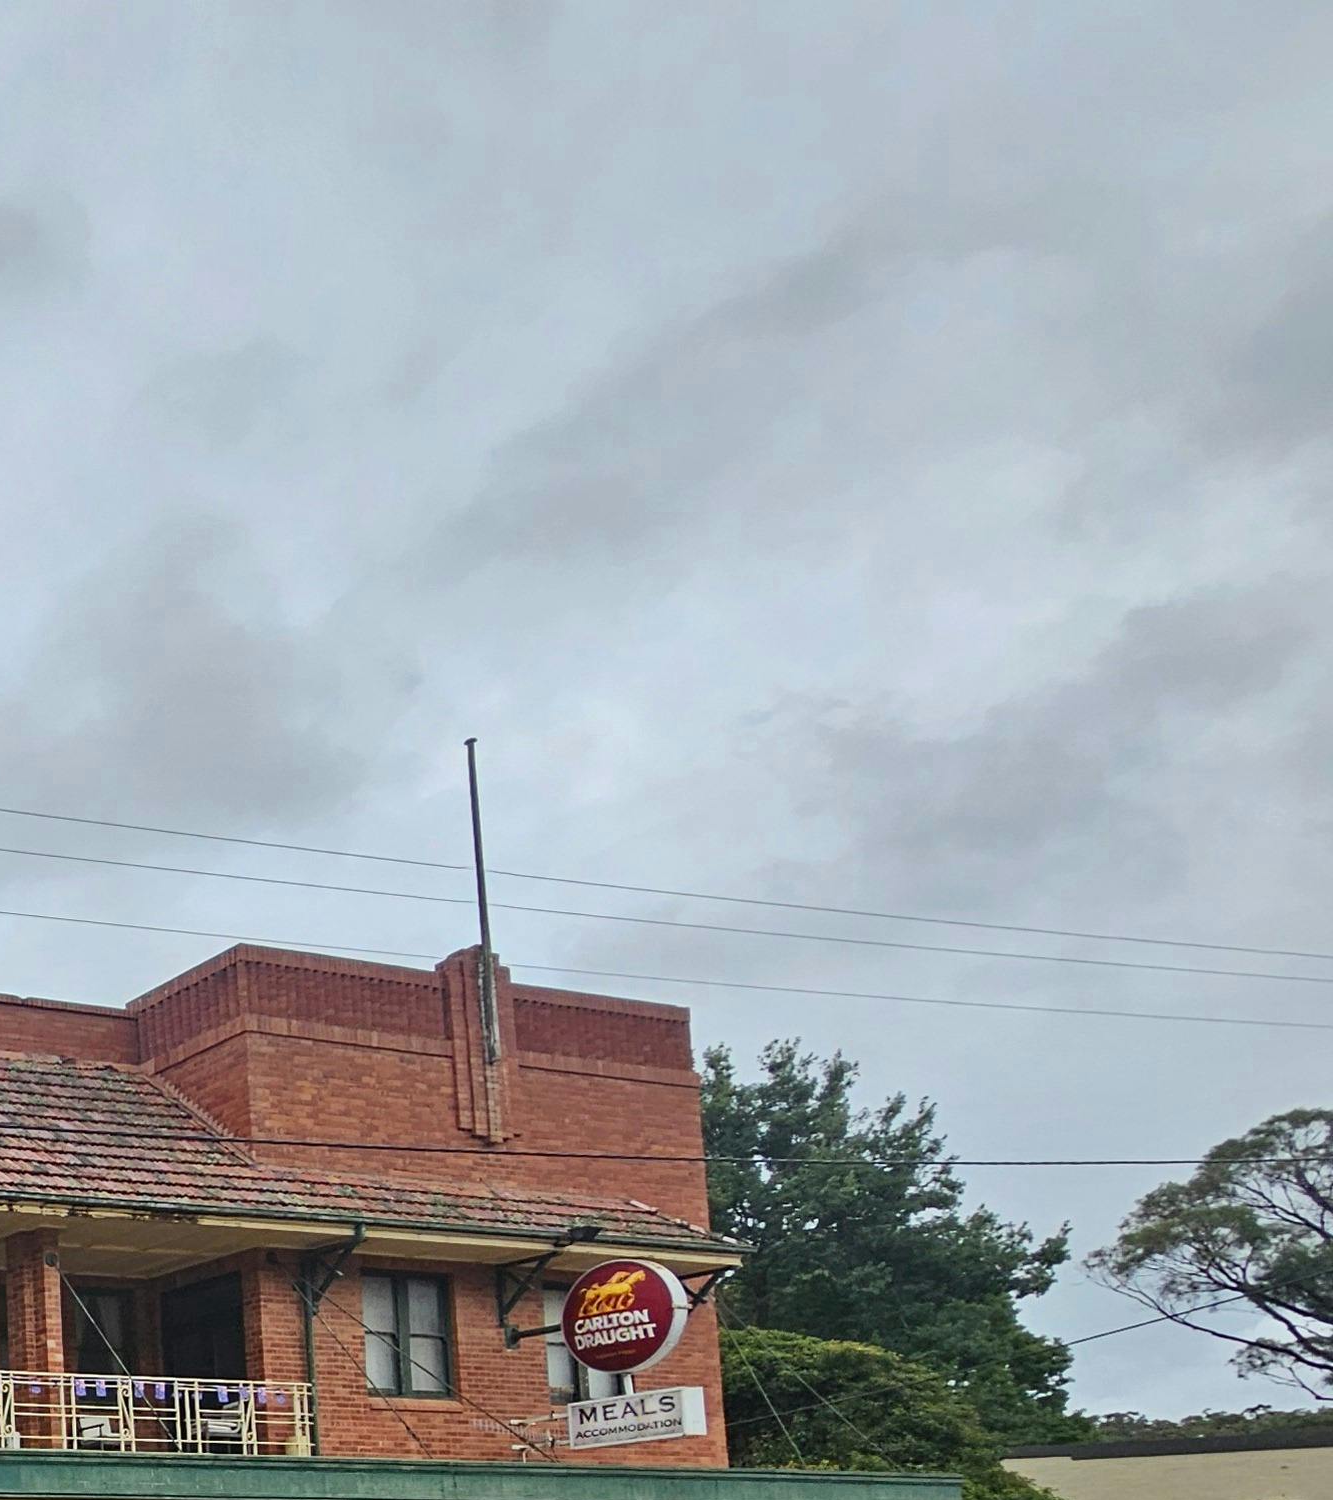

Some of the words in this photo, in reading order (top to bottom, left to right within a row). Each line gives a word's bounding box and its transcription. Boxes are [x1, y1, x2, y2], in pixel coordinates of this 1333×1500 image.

[574, 1308, 649, 1334] CARLTON
[574, 1323, 657, 1350] DRAUGHT
[578, 1396, 676, 1425] MEALS
[575, 1418, 683, 1440] ACCOMMODATION
